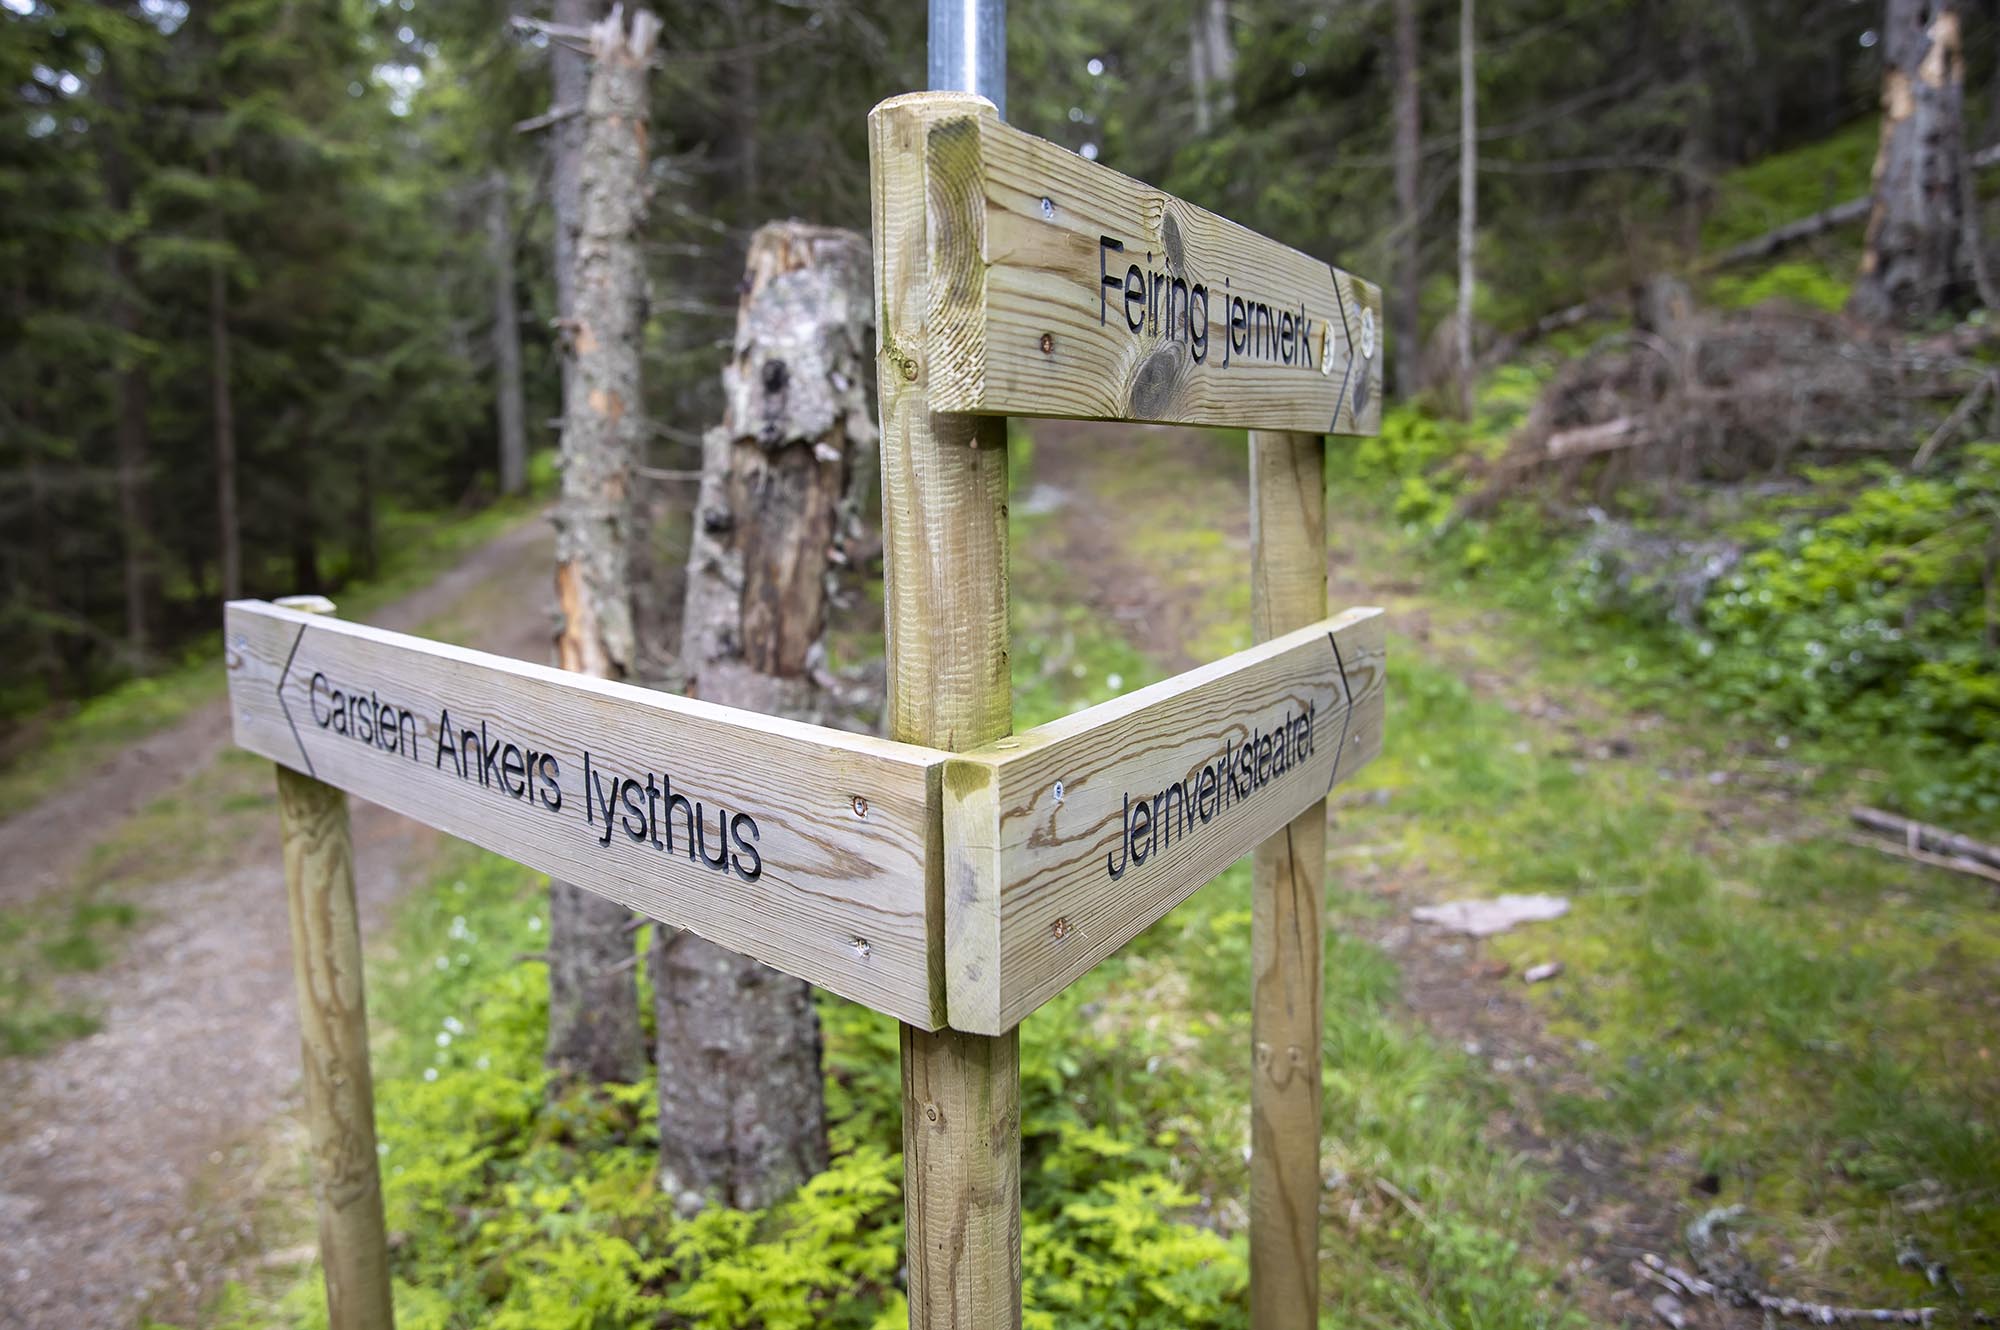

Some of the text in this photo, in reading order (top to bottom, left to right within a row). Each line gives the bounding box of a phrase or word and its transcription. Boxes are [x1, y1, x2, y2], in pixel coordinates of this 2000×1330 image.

[1100, 235, 1312, 369] Feiring jernverk
[310, 672, 762, 882] Carsten Ankers lysthus
[1107, 698, 1315, 881] Jernverksteatret
